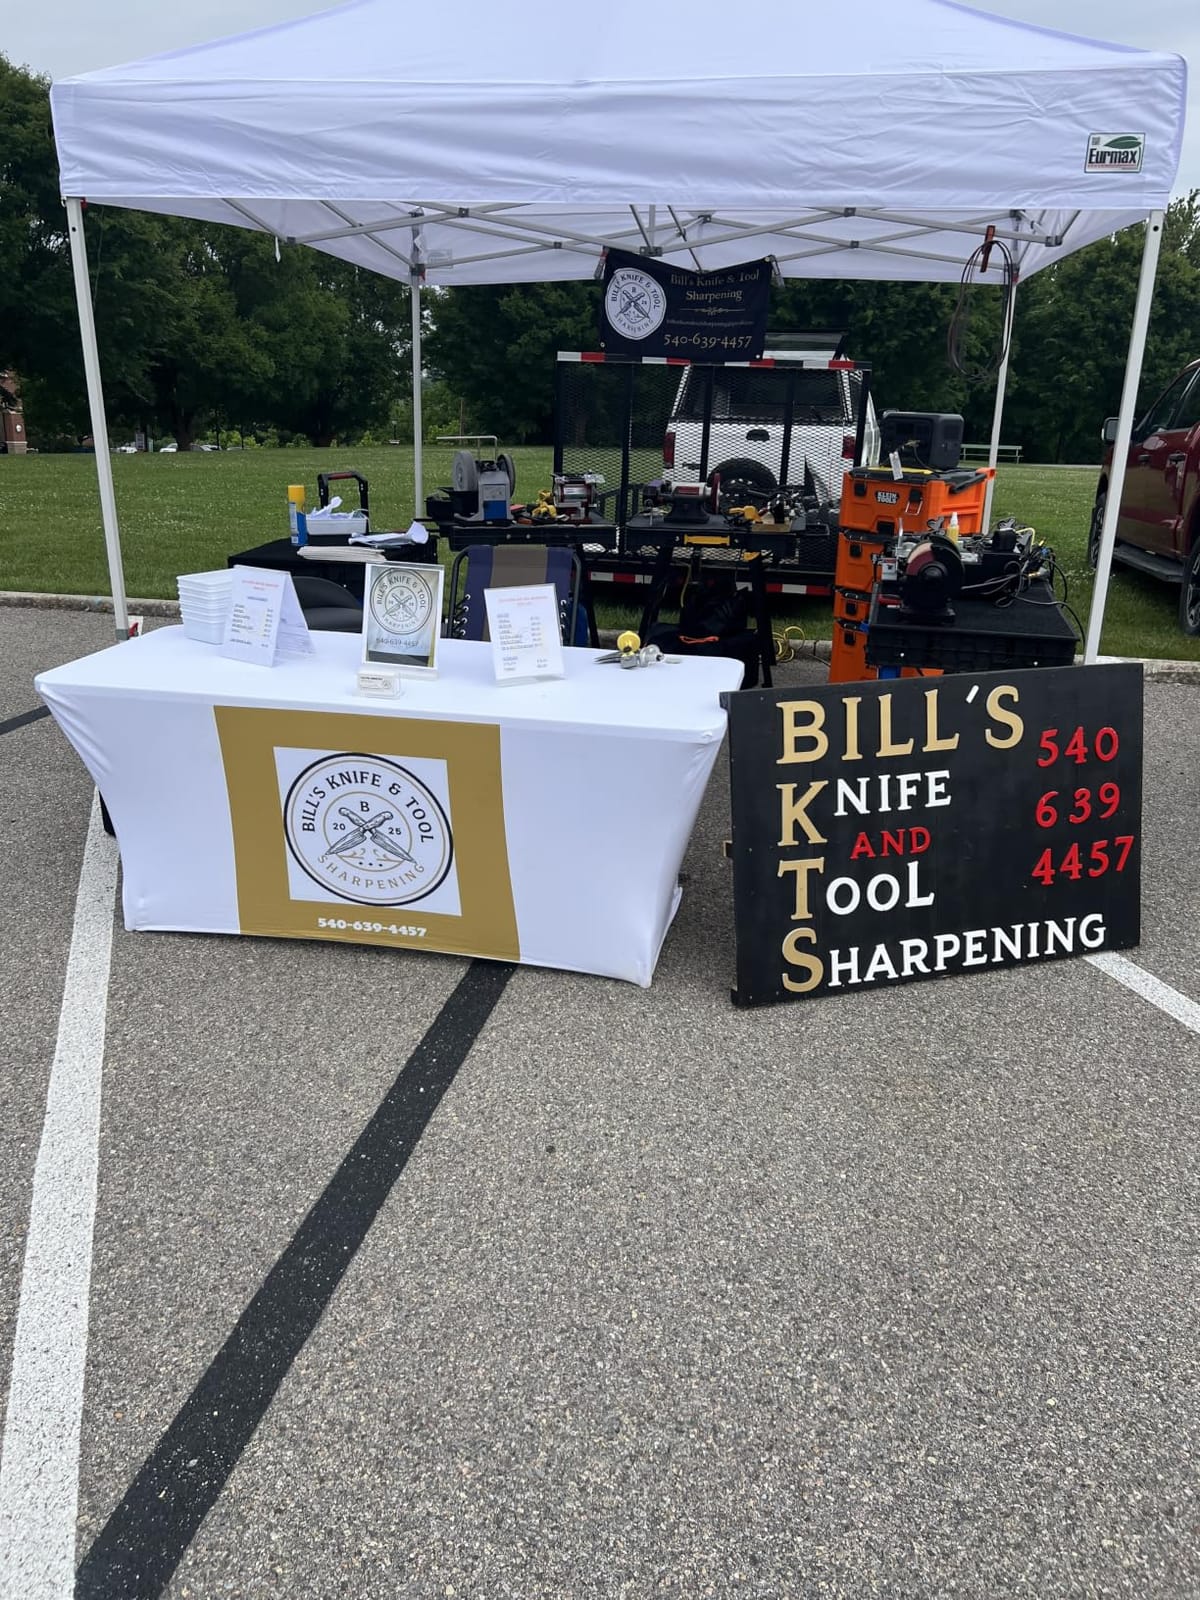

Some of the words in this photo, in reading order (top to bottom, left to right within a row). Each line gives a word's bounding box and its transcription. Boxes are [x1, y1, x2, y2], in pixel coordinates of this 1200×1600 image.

[1088, 148, 1138, 164] Eurmax
[620, 273, 644, 283] KNIFE
[650, 289, 661, 310] TOOL
[739, 268, 760, 282] Tool
[685, 290, 743, 303] Sharpening
[663, 332, 753, 349] 540-639-4457
[877, 491, 897, 499] KLEIN
[388, 575, 411, 585] KNIFE
[776, 685, 1024, 764] BILL'S
[1036, 726, 1119, 767] 540
[302, 786, 326, 833] BILL'S
[326, 770, 382, 790] KNIFE
[388, 782, 401, 796] &
[405, 796, 434, 843] TOOL
[360, 801, 370, 813] B
[776, 770, 952, 847] KNIFE
[1035, 782, 1121, 828] 639
[332, 822, 346, 831] 20
[388, 827, 402, 836] 25
[849, 826, 932, 860] AND
[318, 854, 425, 890] SHARPENING
[1032, 835, 1135, 886] 4457
[317, 917, 428, 937] 540-639-4457
[781, 913, 1107, 993] SHARPENING
